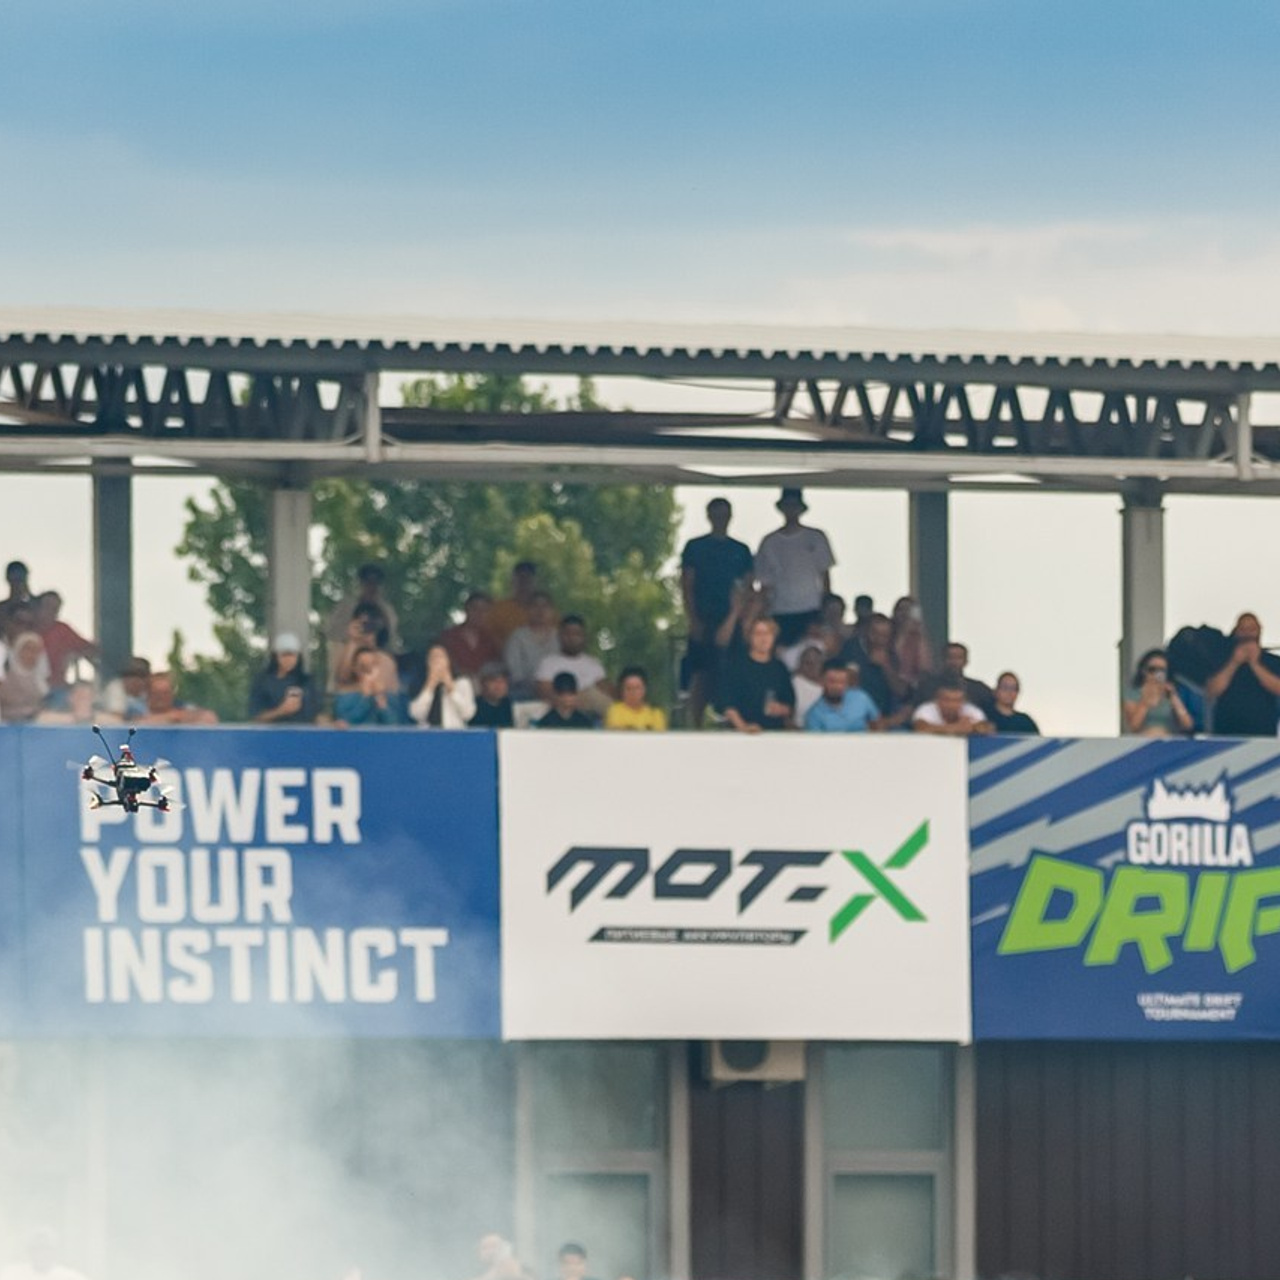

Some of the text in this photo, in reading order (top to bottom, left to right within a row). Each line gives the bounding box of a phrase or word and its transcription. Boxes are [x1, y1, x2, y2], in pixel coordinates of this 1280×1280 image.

[80, 767, 362, 844] POWER
[1126, 822, 1253, 866] GORILLA
[79, 847, 294, 923] YOUR
[83, 927, 450, 1003] INSTINCT
